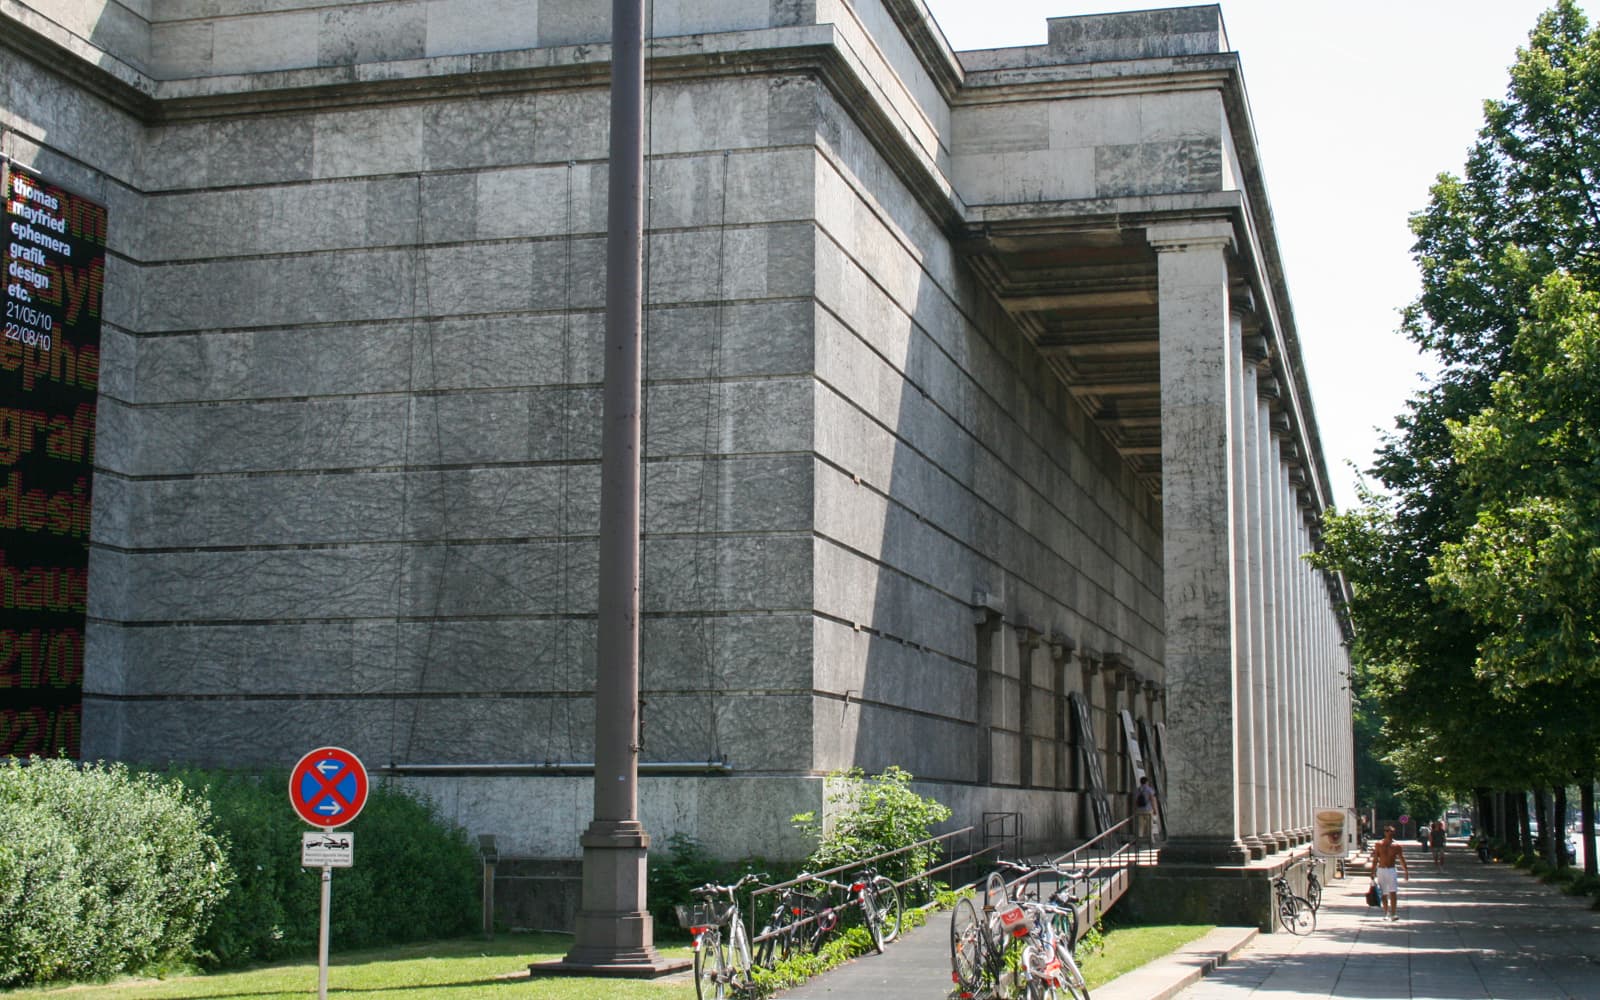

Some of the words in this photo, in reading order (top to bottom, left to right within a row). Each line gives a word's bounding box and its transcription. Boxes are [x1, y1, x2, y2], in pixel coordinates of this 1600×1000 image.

[13, 177, 58, 210] thomas
[12, 201, 65, 234] mayfried
[11, 221, 71, 256] ephemera
[10, 242, 46, 266] grafik
[9, 261, 49, 289] design
[8, 284, 31, 303] etc.
[6, 301, 52, 330] 21/05/10
[5, 322, 51, 351] 22/08/10
